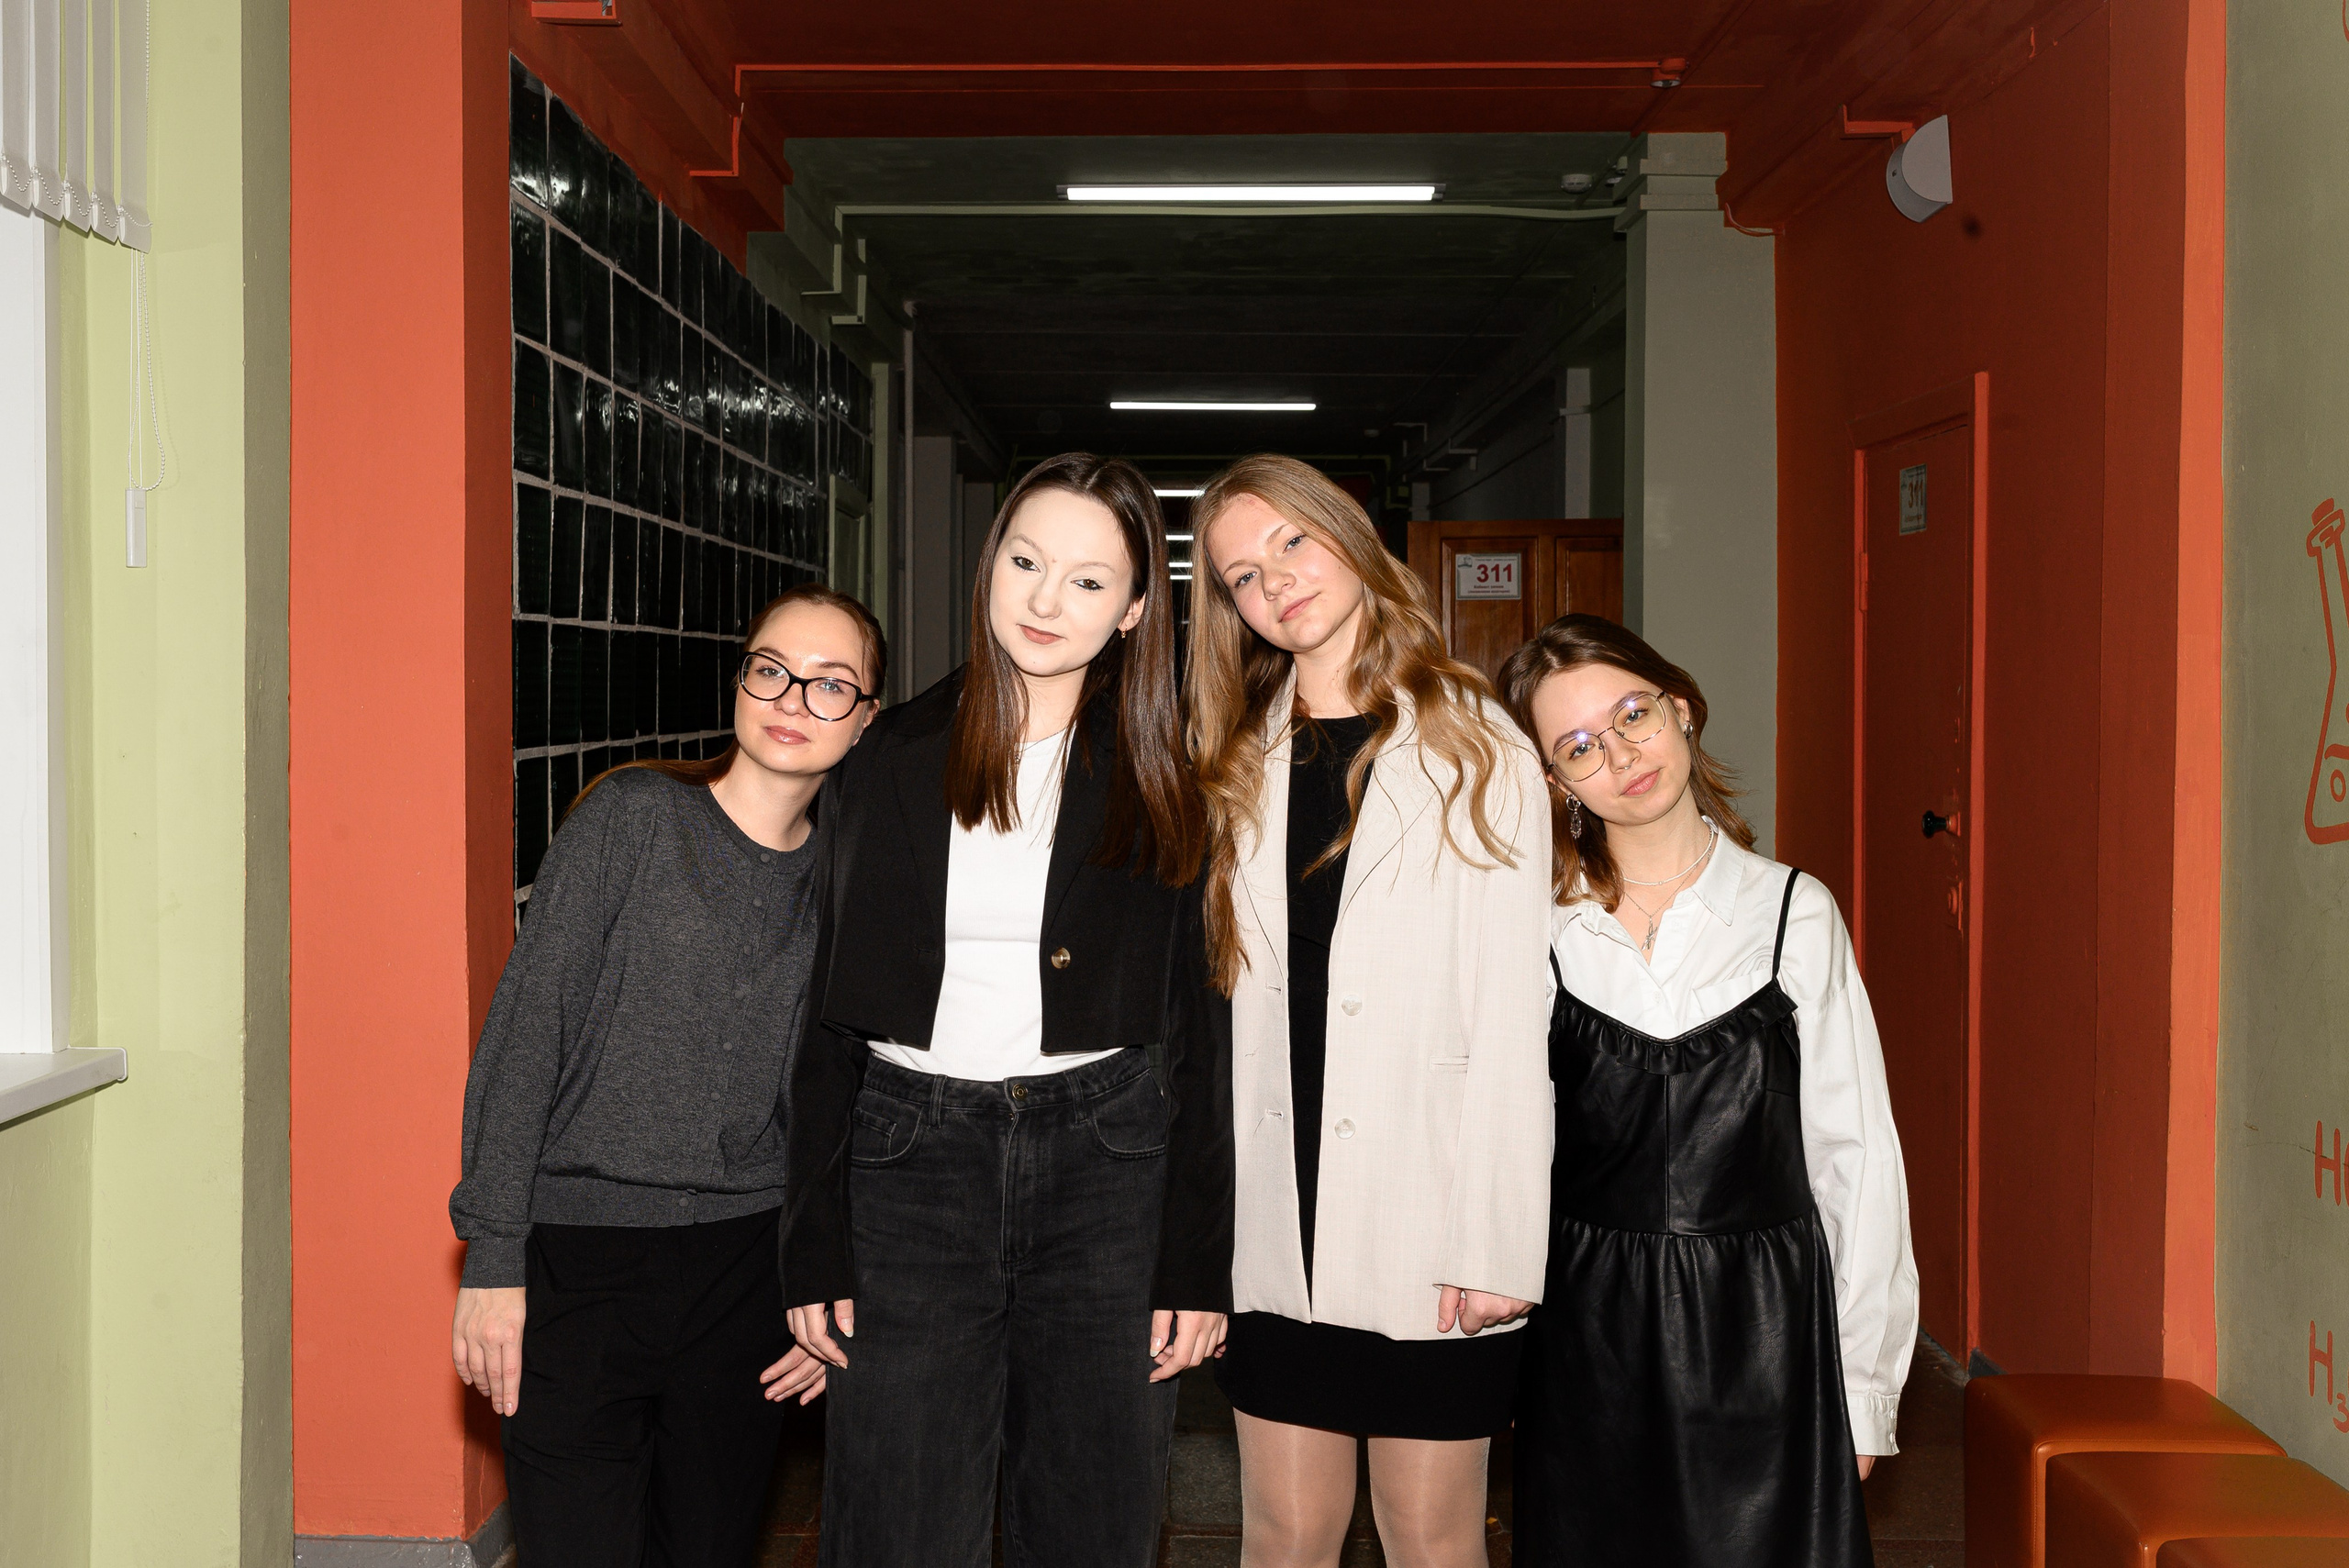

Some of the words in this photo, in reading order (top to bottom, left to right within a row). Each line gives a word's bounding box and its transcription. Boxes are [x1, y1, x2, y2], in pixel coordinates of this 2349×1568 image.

[1476, 563, 1512, 583] 311
[2315, 1120, 2349, 1207] H
[2309, 1320, 2349, 1433] H3
